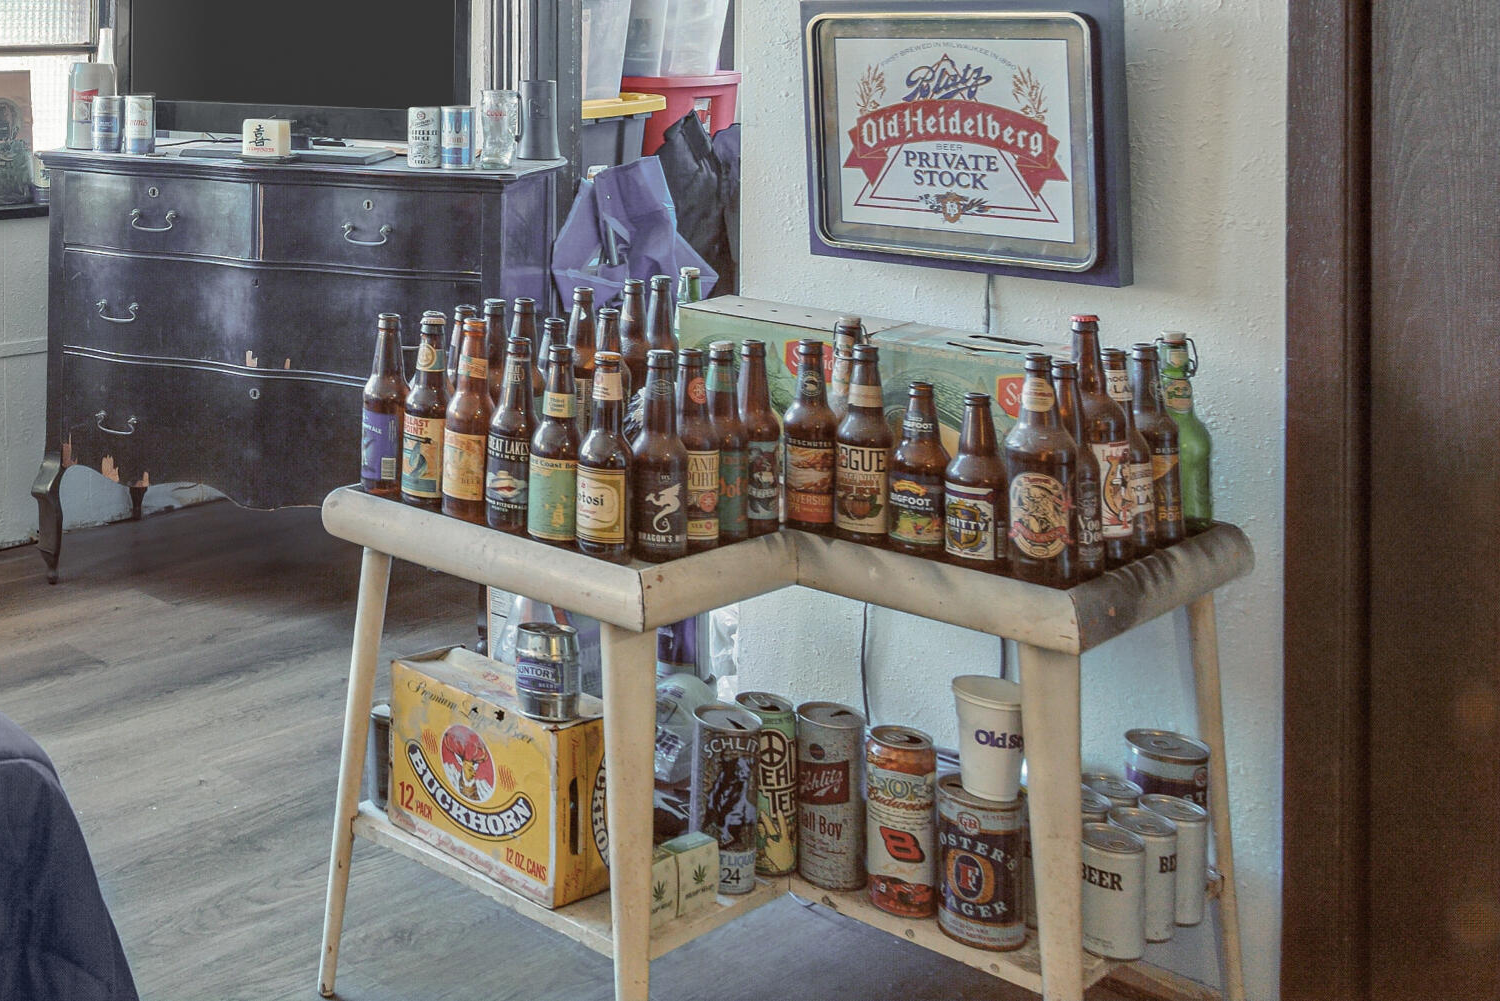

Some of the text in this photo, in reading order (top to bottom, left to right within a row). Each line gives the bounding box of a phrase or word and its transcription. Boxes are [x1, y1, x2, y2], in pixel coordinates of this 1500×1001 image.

[902, 62, 993, 102] Blatz
[861, 107, 1043, 157] Old Heidelberg
[935, 142, 963, 151] BEER
[903, 150, 1001, 173] PRIVATE
[913, 169, 989, 191] STOCK
[577, 494, 605, 506] otosi
[974, 729, 1007, 749] Old
[399, 780, 433, 821] 12 PACK
[409, 749, 533, 836] BUCKHORN
[818, 815, 843, 840] Boy
[880, 825, 926, 864] 8
[940, 832, 1018, 872] OSTER'S
[505, 847, 514, 865] 12
[526, 859, 547, 882] CANS
[720, 867, 741, 884] 24
